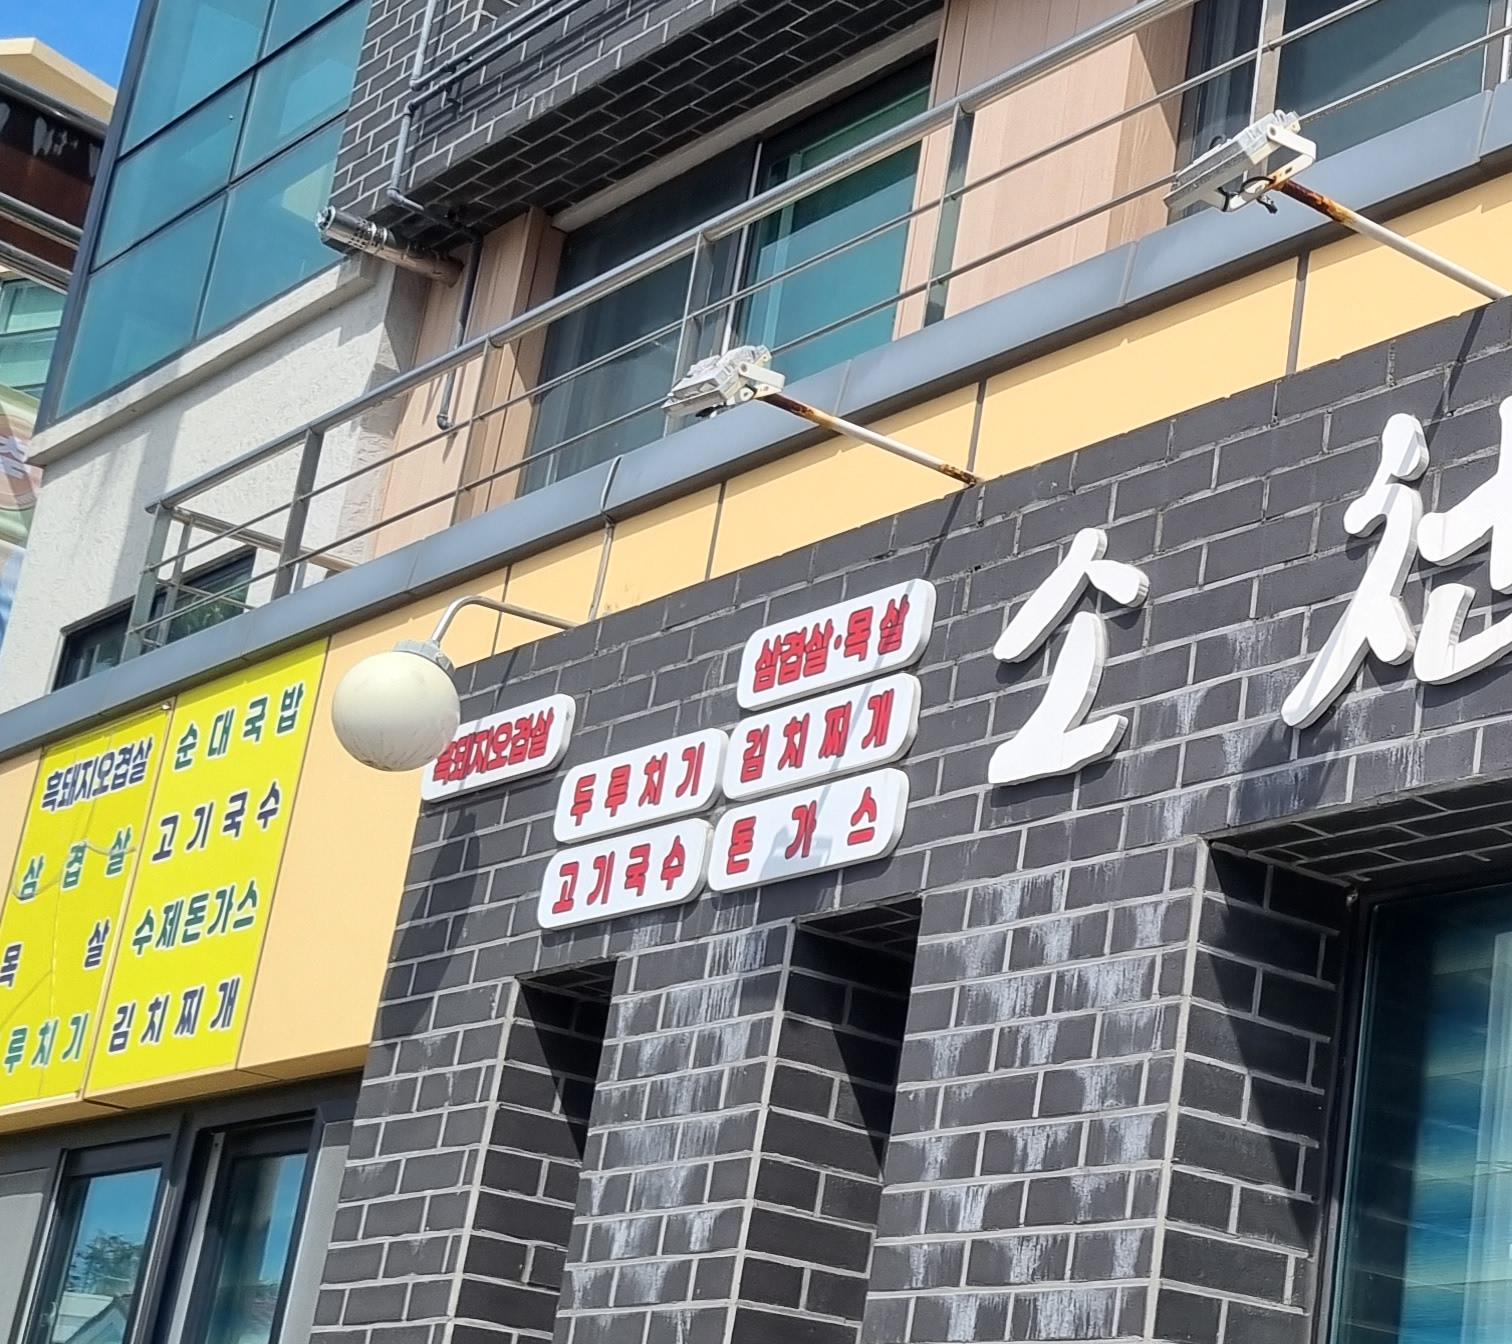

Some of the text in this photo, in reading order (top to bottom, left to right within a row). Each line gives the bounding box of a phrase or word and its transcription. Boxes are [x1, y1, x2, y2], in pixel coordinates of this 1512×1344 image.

[174, 682, 305, 770] 순대국밥
[740, 688, 894, 784] 김치찌개
[41, 736, 153, 811] 흑돼지오겹살
[570, 740, 705, 827] 두루치기
[152, 781, 282, 862] 고기국수
[725, 786, 878, 876] 돈가스
[18, 826, 131, 902] 삼겹살
[552, 835, 685, 915] 고기국수
[131, 880, 259, 957] 수제돈가스
[108, 976, 241, 1053] 김치찌개
